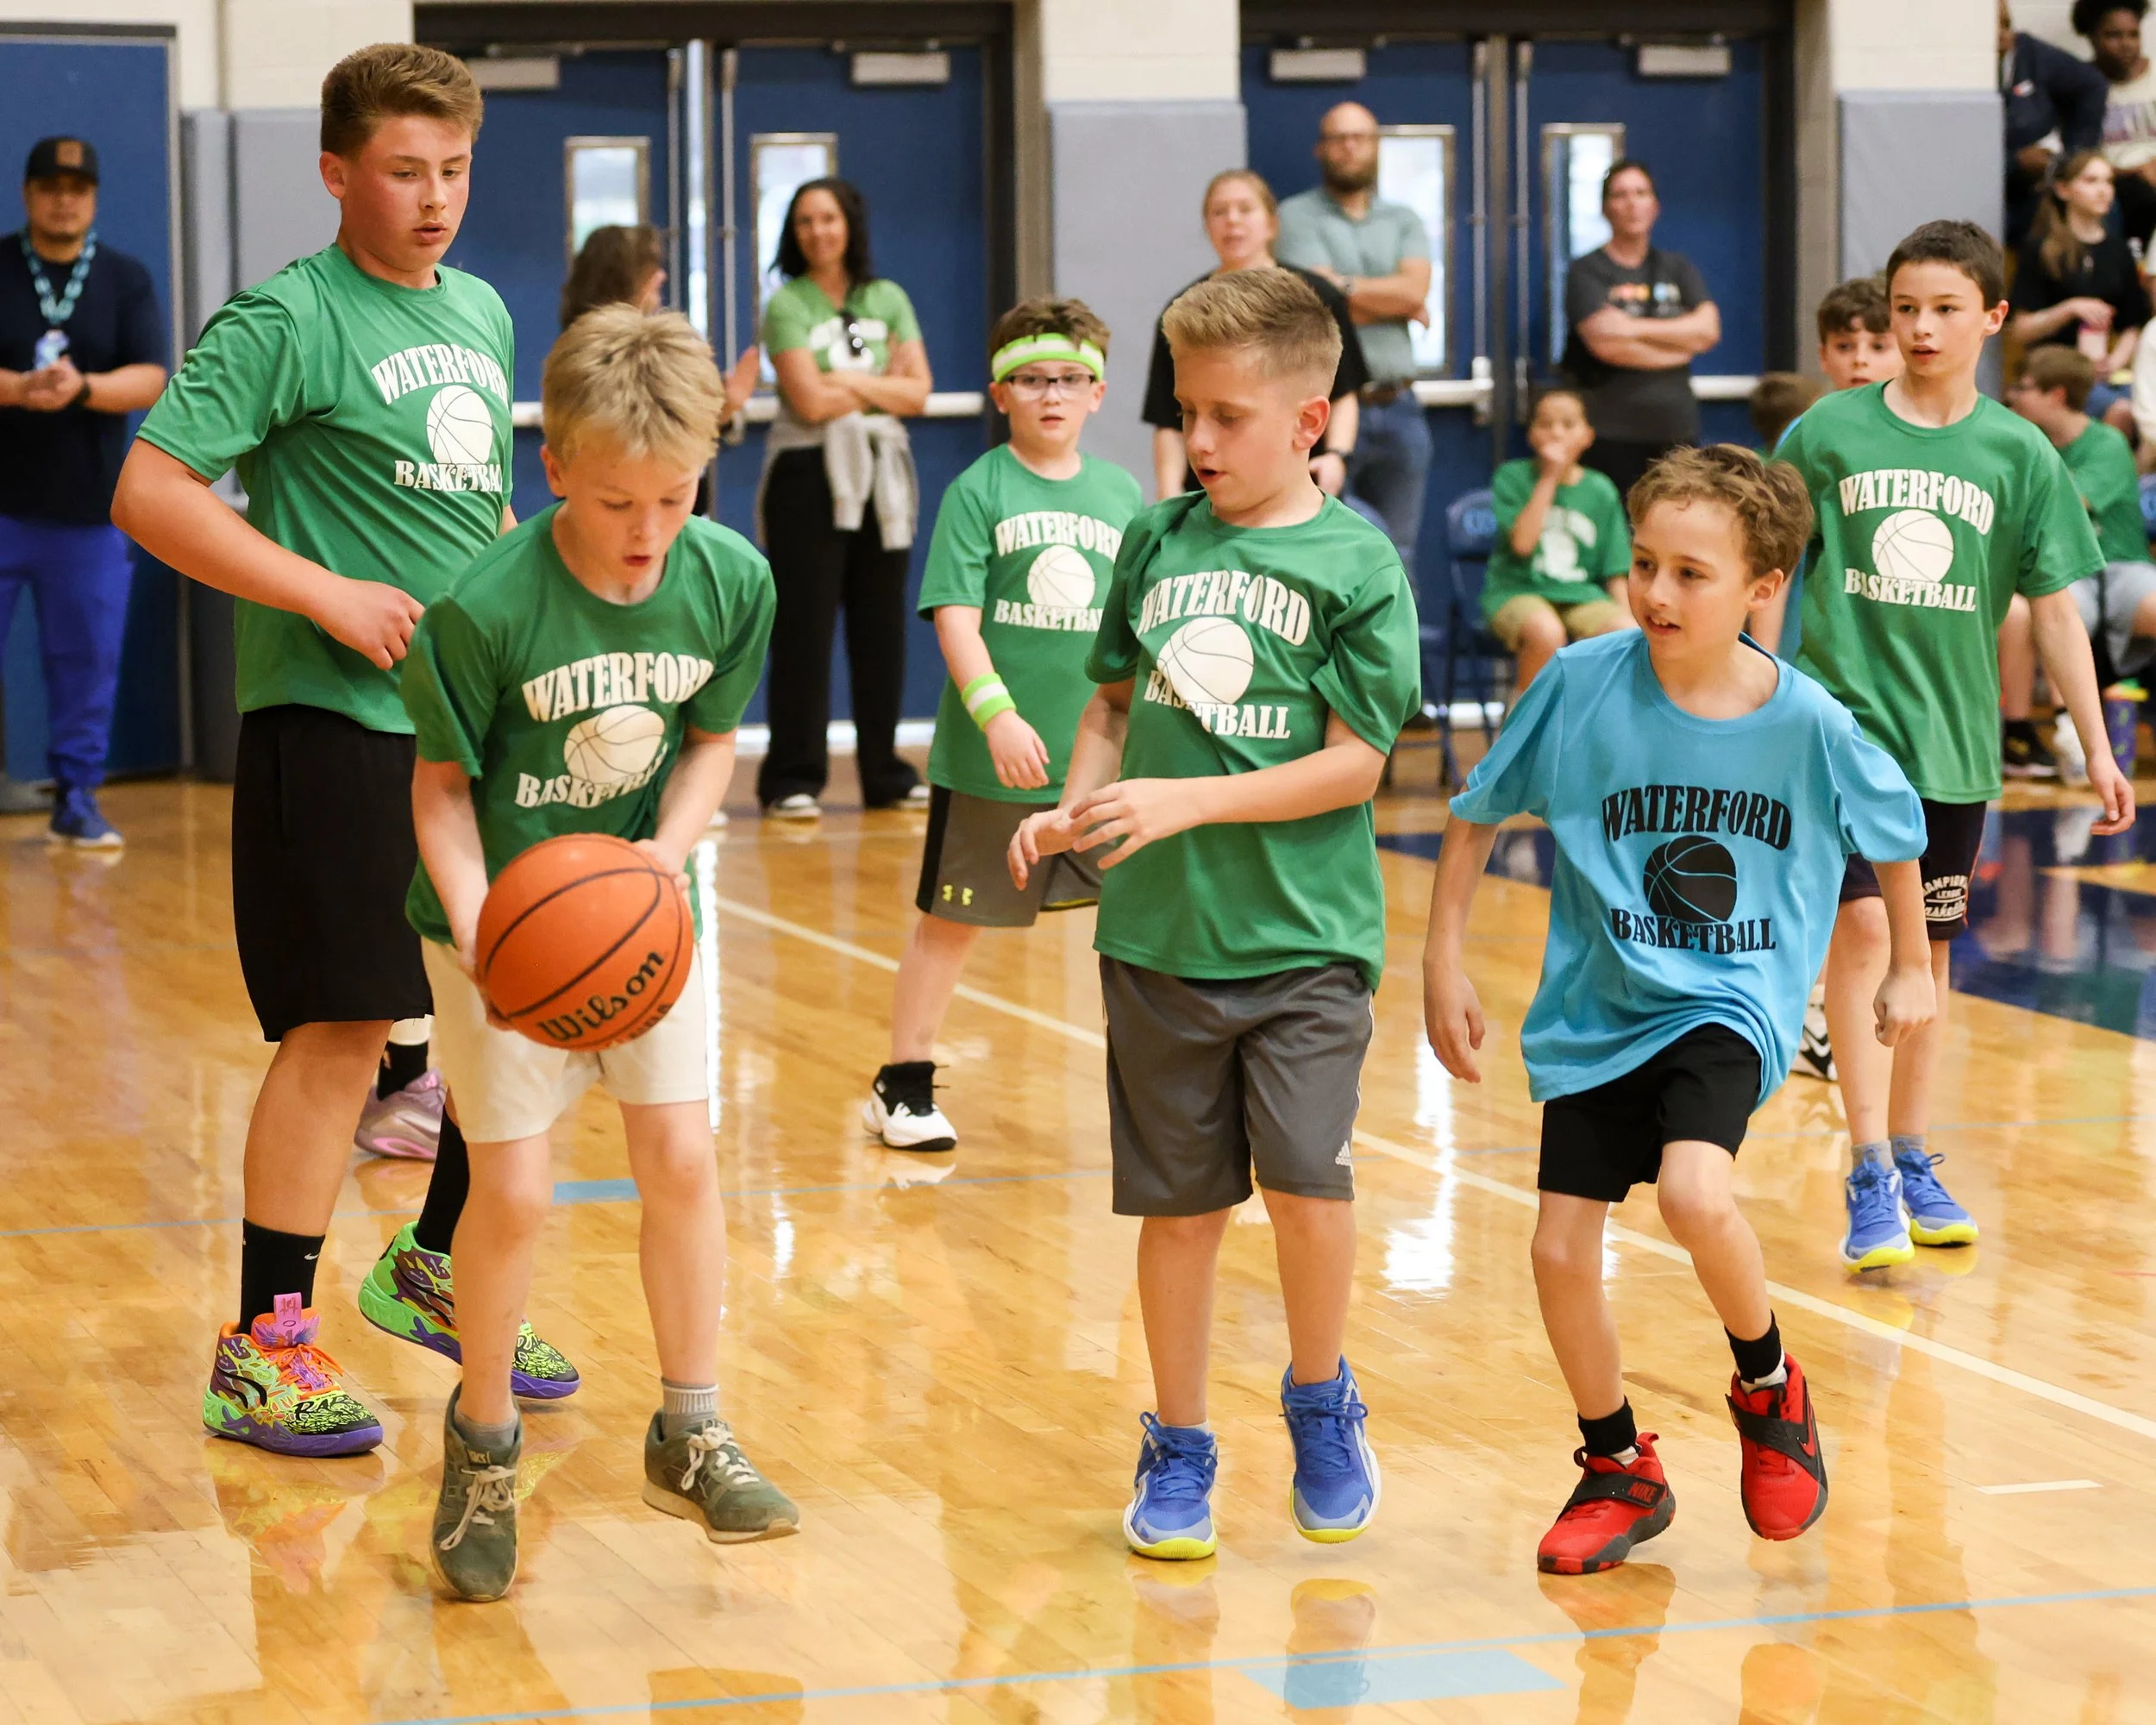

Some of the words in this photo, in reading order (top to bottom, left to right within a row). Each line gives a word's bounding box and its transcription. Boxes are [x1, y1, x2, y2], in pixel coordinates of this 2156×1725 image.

[394, 460, 503, 492] BASKETBA
[1839, 468, 1995, 536] WATERFORD
[993, 598, 1104, 632] BASKETBA
[1135, 570, 1310, 646] WATERFORD
[1601, 784, 1792, 851] WATERFORD
[1610, 907, 1777, 955] BASKETBALL
[537, 950, 665, 1042] Wilson
[1627, 1481, 1658, 1504] NIKE
